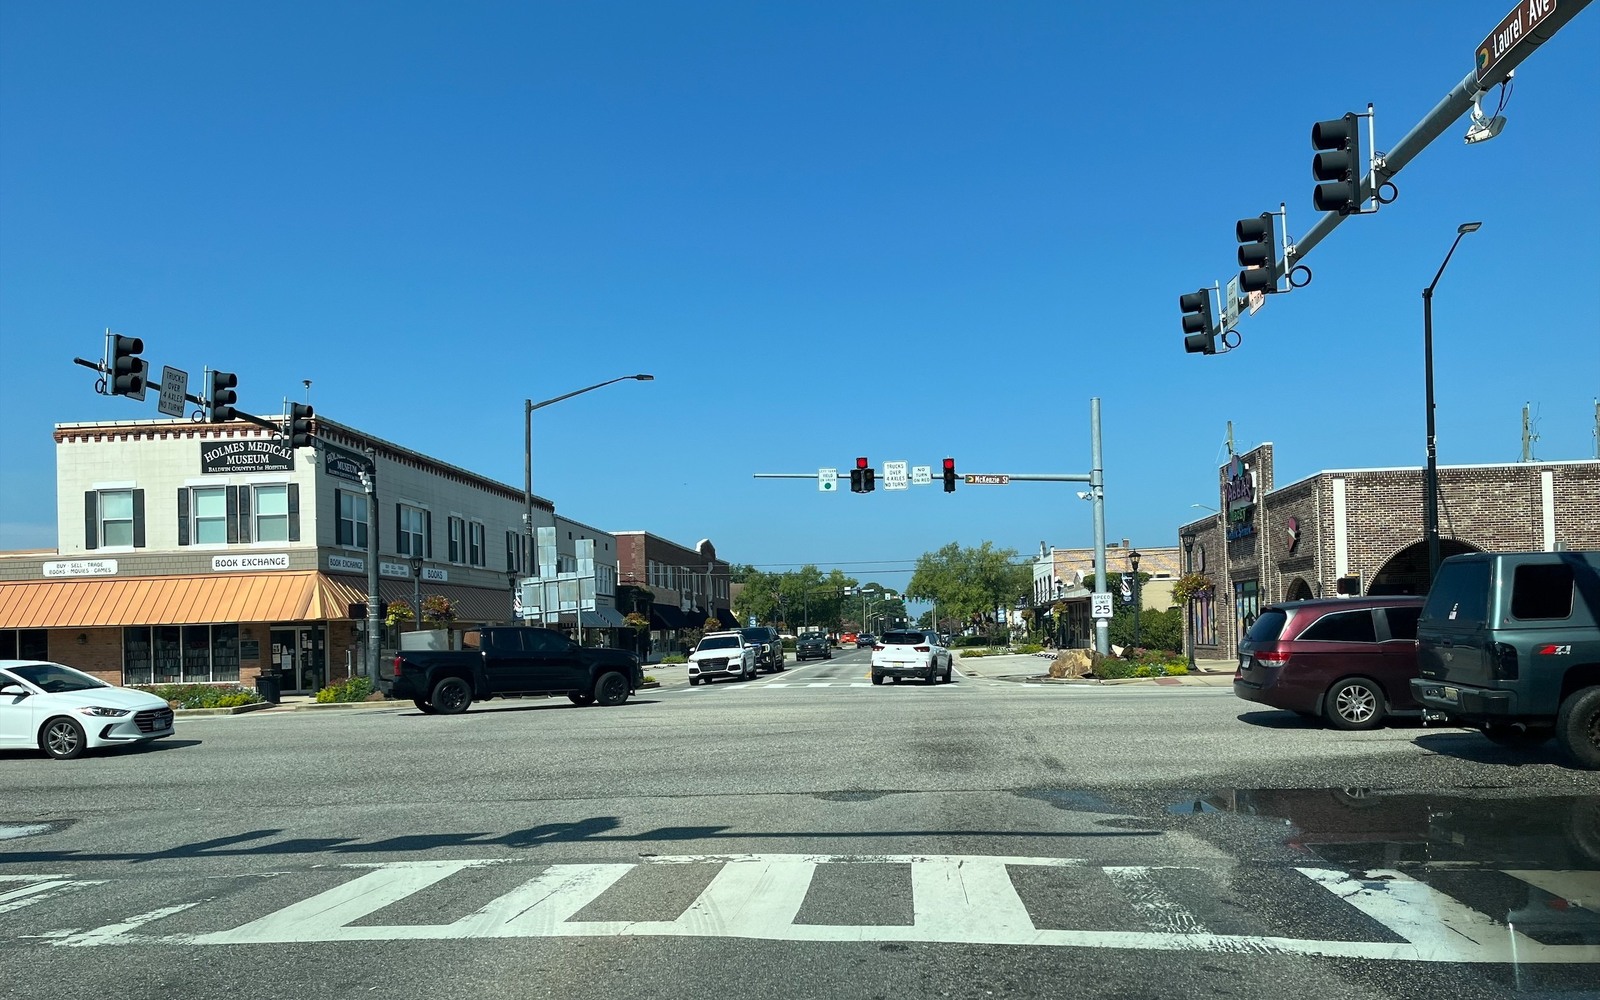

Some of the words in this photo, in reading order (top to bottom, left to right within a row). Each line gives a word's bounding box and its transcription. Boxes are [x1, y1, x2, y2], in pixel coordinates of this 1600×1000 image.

[1493, 8, 1522, 58] Laurel
[1528, 0, 1549, 26] Ave
[166, 372, 184, 384] TRUCKS
[168, 382, 180, 392] OVER
[168, 393, 183, 403] AXLES
[160, 401, 167, 409] NO
[168, 402, 184, 413] TURNS
[204, 442, 245, 463] HOLMES
[248, 442, 292, 460] MEDICAL
[226, 454, 269, 465] MUSEUM
[974, 476, 999, 484] McKenzie
[1003, 476, 1009, 484] St
[215, 559, 238, 567] BOOK
[242, 557, 286, 567] EXCHANGE
[330, 558, 341, 567] BOOK
[342, 559, 363, 570] EXCHANGE
[428, 570, 443, 579] BOOKS
[1094, 605, 1110, 614] 25
